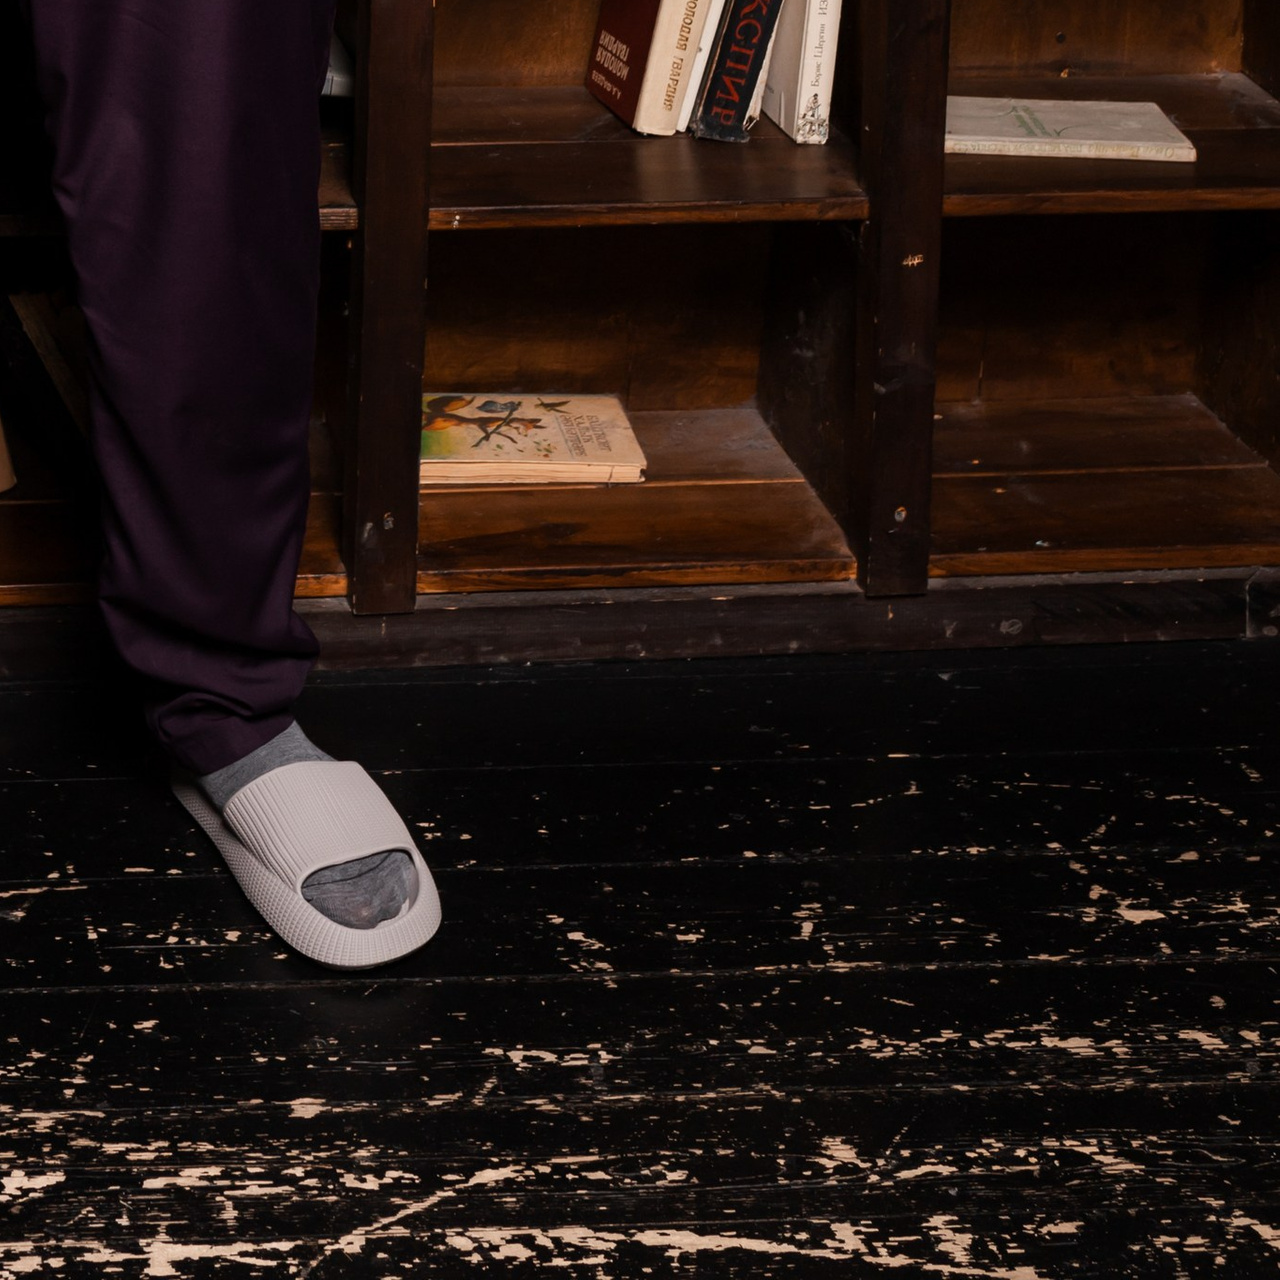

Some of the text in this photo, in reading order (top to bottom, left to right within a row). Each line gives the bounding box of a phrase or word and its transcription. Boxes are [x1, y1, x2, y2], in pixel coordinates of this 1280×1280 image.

[595, 28, 631, 62] ГВАРДИЯ
[813, 21, 829, 58] Шергин
[592, 45, 630, 80] МОЛОДАЯ
[810, 60, 824, 88] Борис
[661, 54, 684, 113] ГВАРДИЯ
